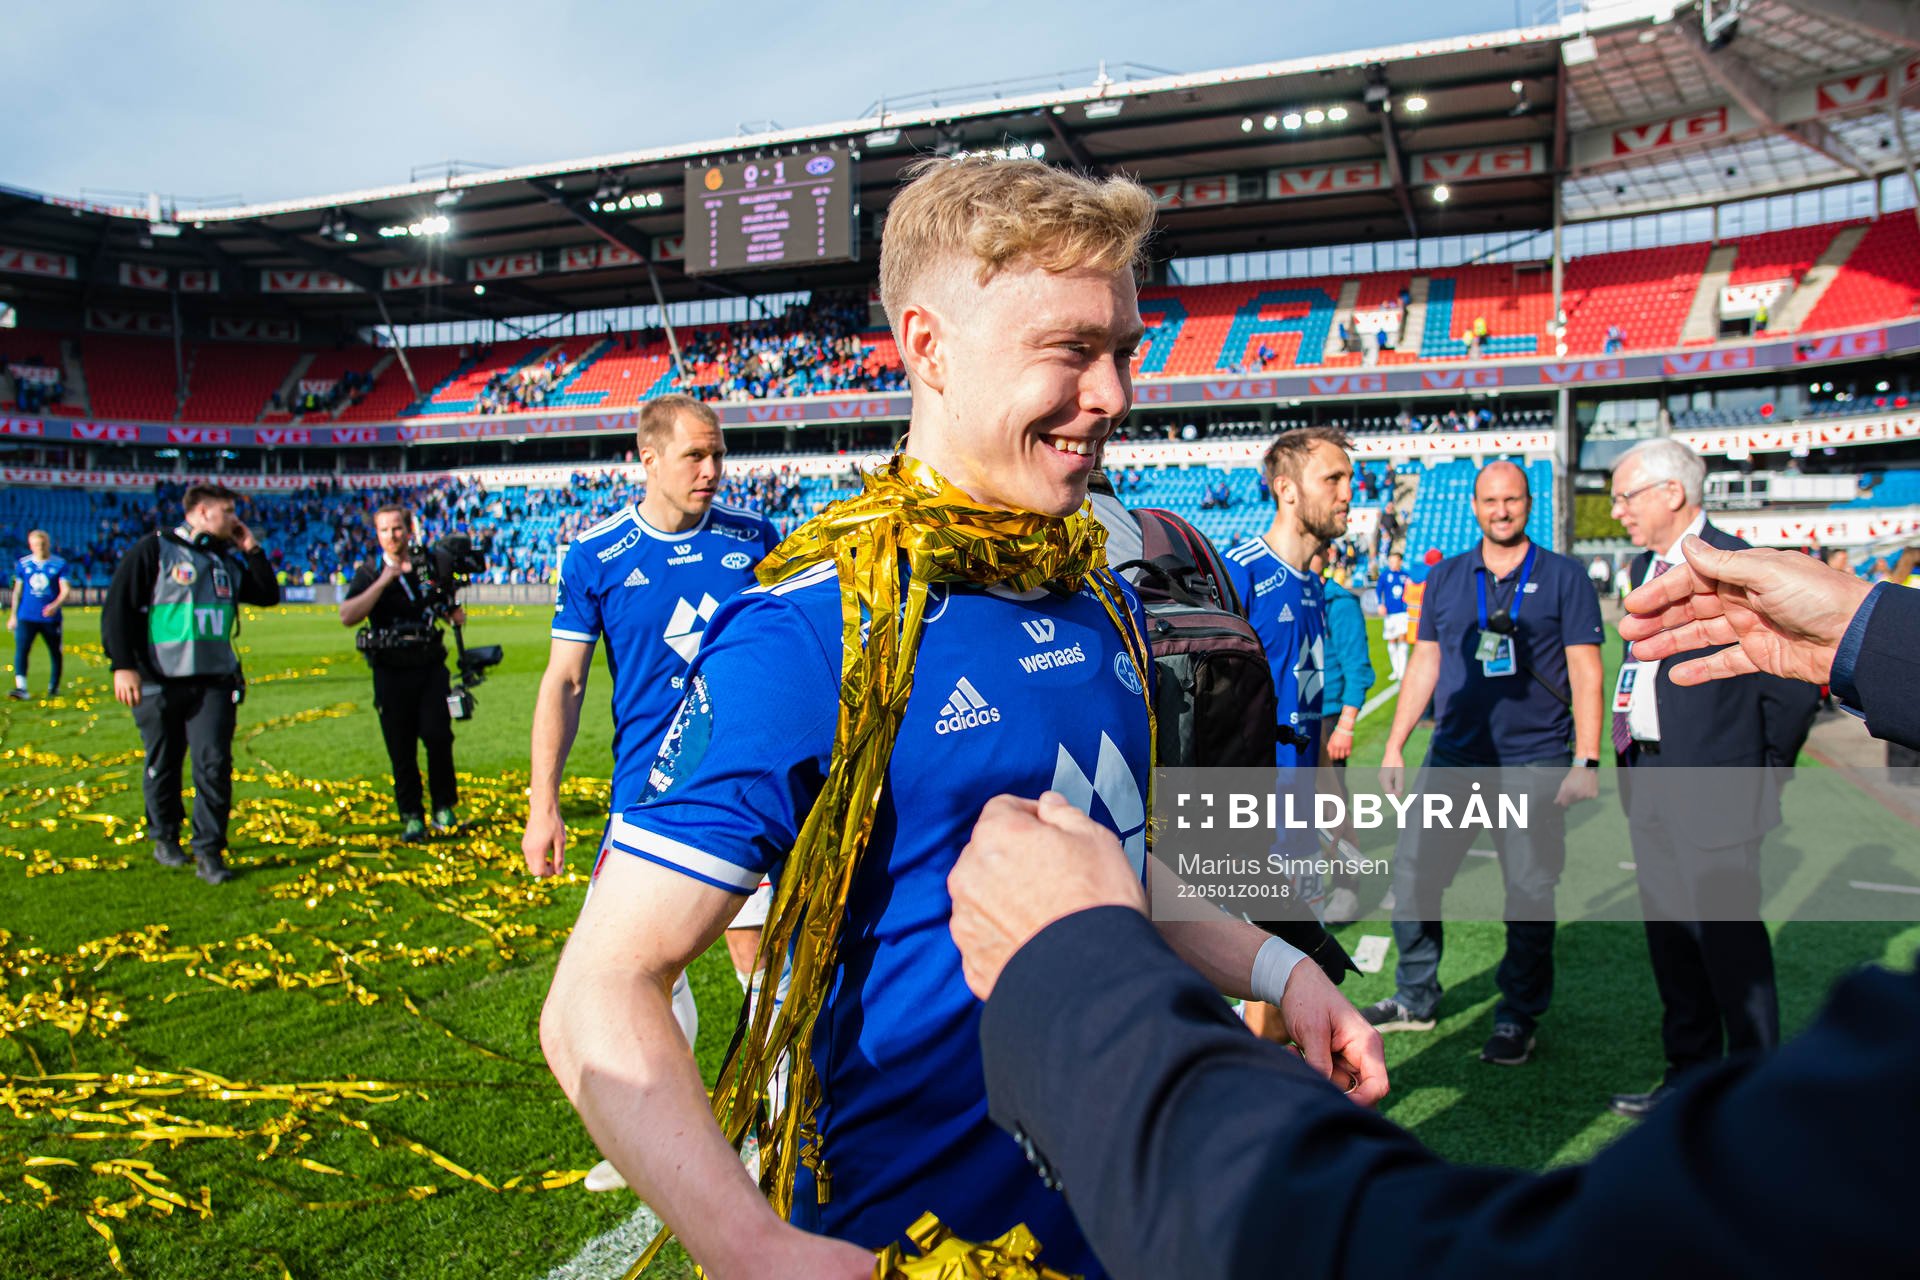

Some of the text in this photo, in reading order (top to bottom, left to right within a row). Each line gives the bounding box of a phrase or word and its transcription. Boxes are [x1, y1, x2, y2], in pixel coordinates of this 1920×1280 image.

[1613, 107, 1727, 155] VG
[743, 165, 759, 183] 0
[774, 161, 784, 178] 1
[1421, 147, 1532, 182] VG
[1278, 161, 1380, 195] VG
[128, 266, 209, 291] VG
[471, 256, 539, 281] VG
[1793, 329, 1887, 362] VG
[1540, 359, 1626, 384] VG
[1663, 347, 1755, 375] VG
[1310, 373, 1387, 395] VG
[1421, 368, 1503, 389] VG
[1203, 380, 1277, 400] VG
[748, 406, 804, 422] VG
[829, 400, 890, 418] VG
[71, 422, 140, 440] VG
[167, 427, 231, 444] VG
[255, 428, 312, 445] VG
[332, 426, 379, 443] VG
[396, 424, 443, 441] VG
[459, 422, 507, 439] VG
[526, 418, 575, 434] VG
[193, 608, 224, 636] TV
[1018, 642, 1086, 674] wenaas
[935, 706, 1001, 735] adidas
